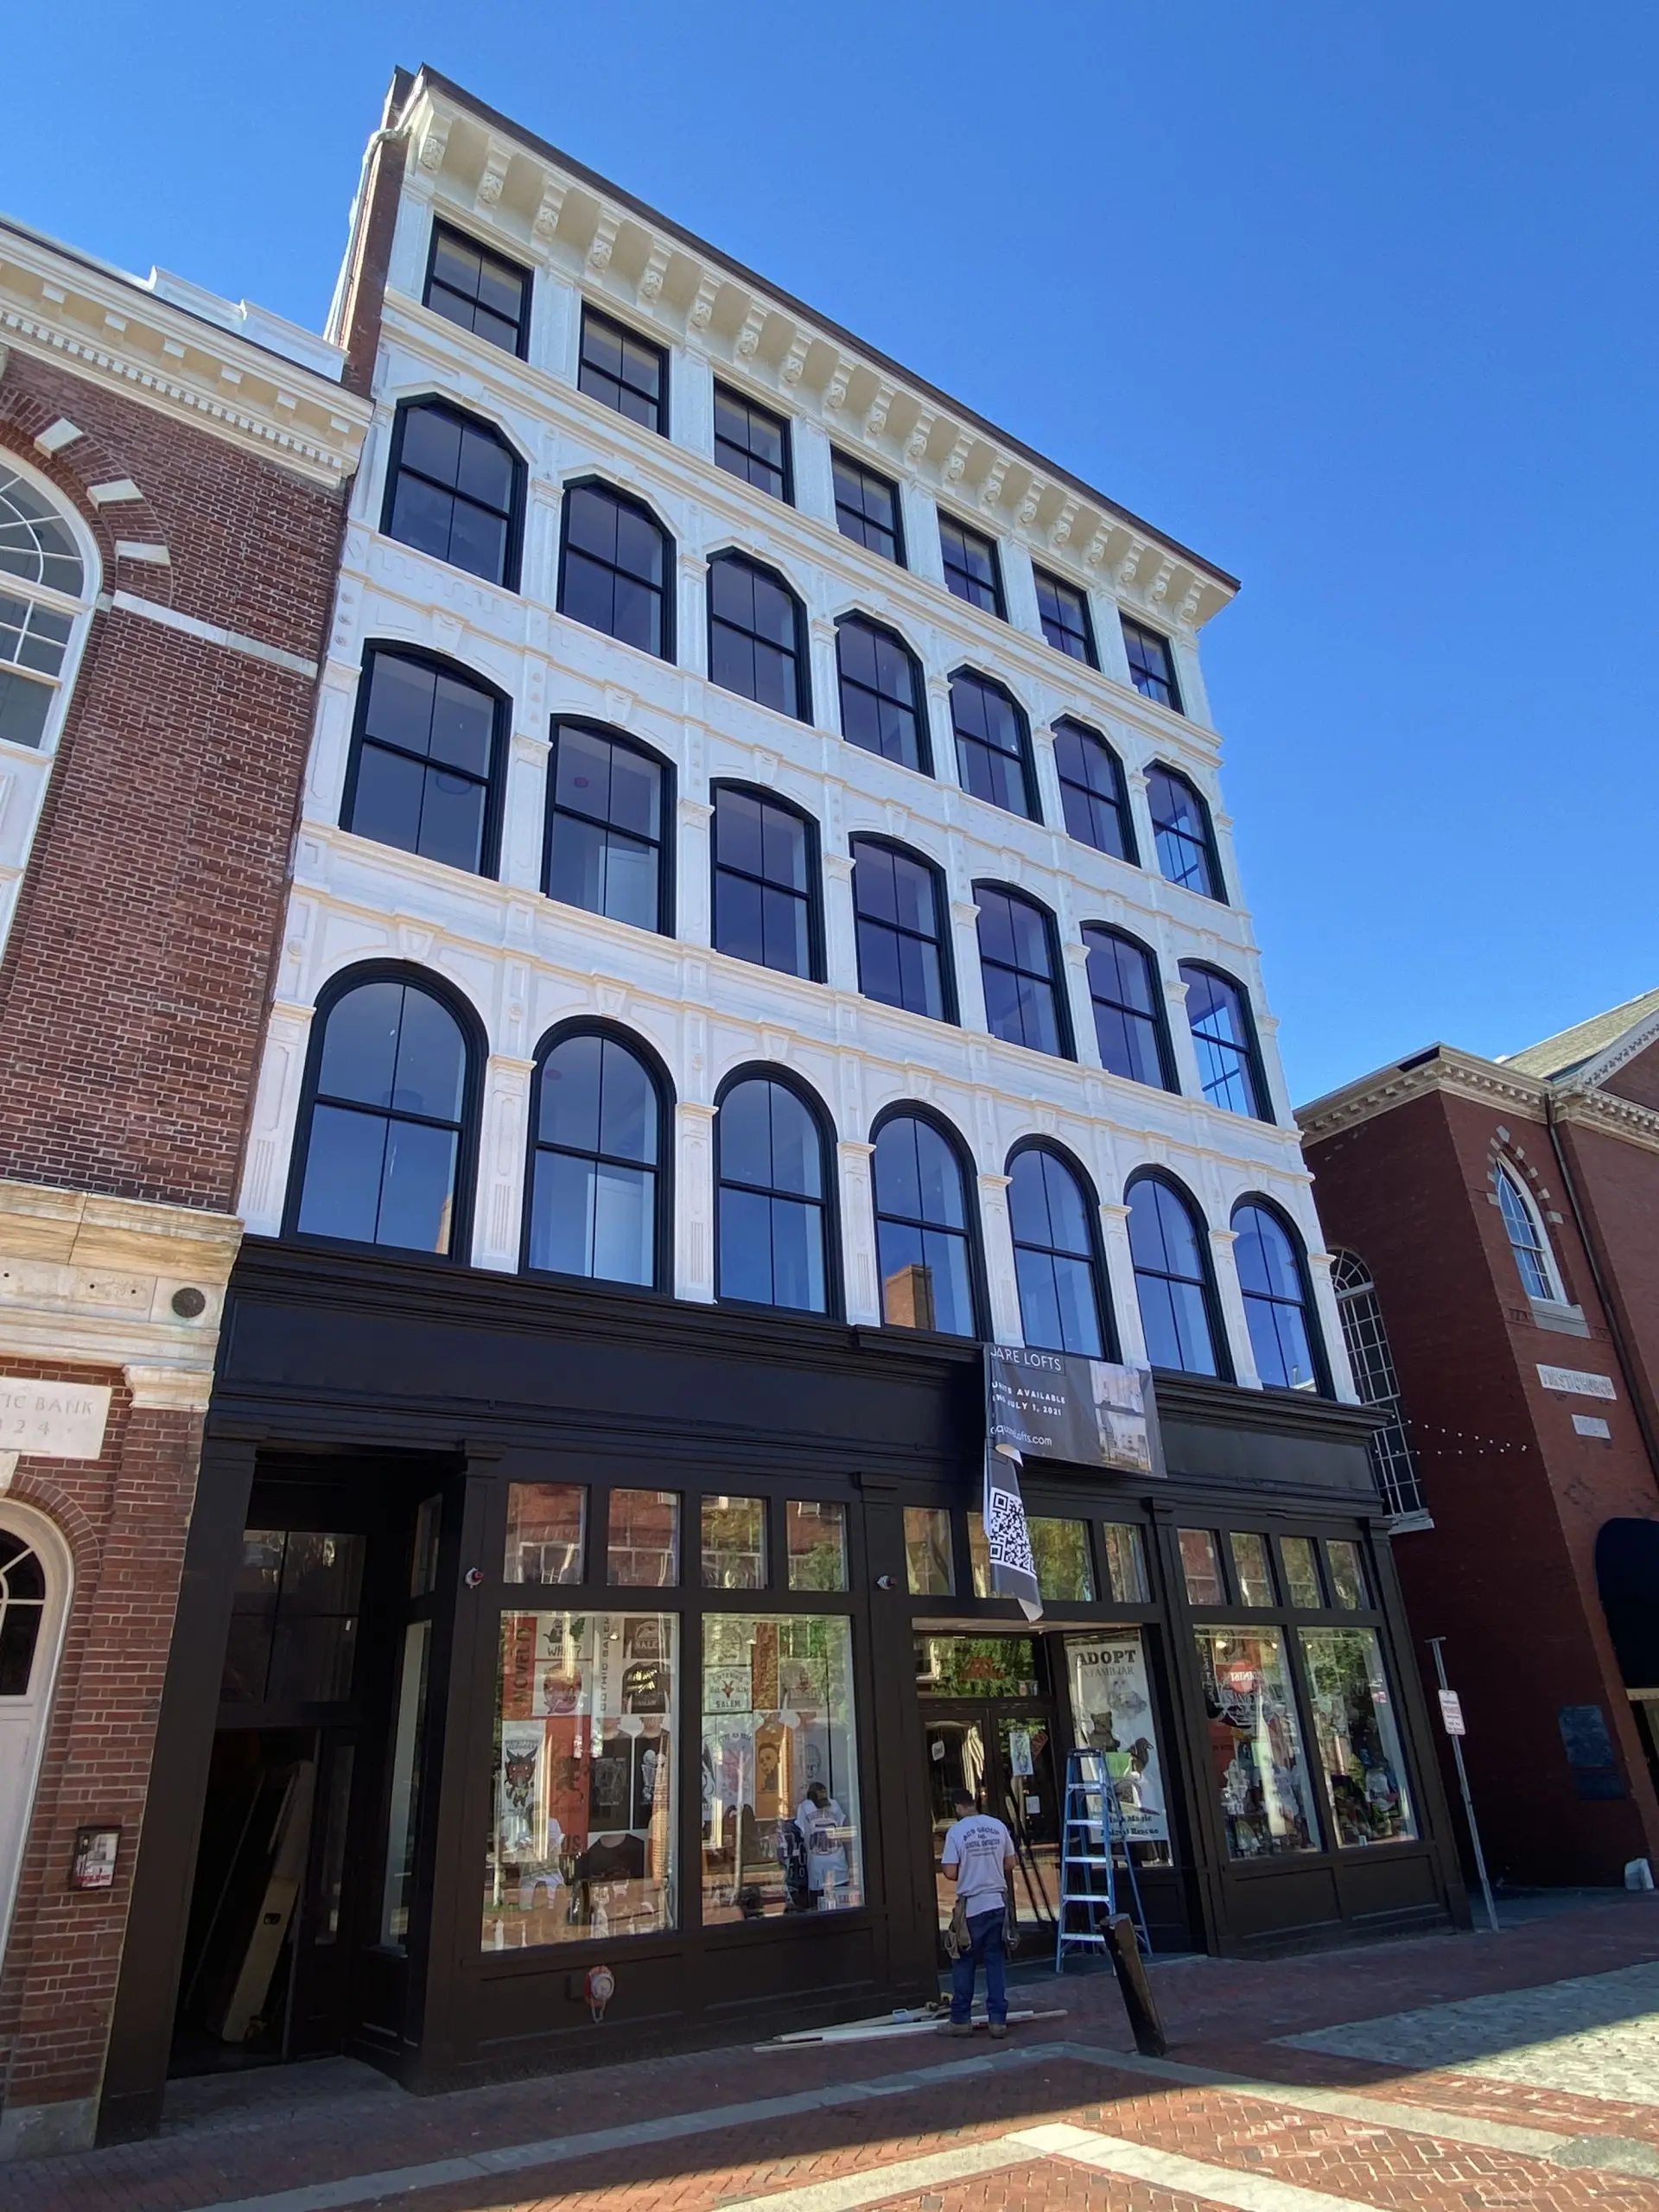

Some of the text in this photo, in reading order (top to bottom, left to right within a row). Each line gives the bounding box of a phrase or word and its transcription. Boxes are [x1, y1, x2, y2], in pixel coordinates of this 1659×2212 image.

[1023, 1352, 1062, 1371] LOFTS
[35, 1396, 92, 1414] BANK
[1016, 1389, 1065, 1405] AVAILABLE
[1007, 1400, 1027, 1411] JULY
[1042, 1406, 1062, 1416] 2021
[1076, 1649, 1136, 1666] ADOPT
[715, 1700, 741, 1708] SALEM
